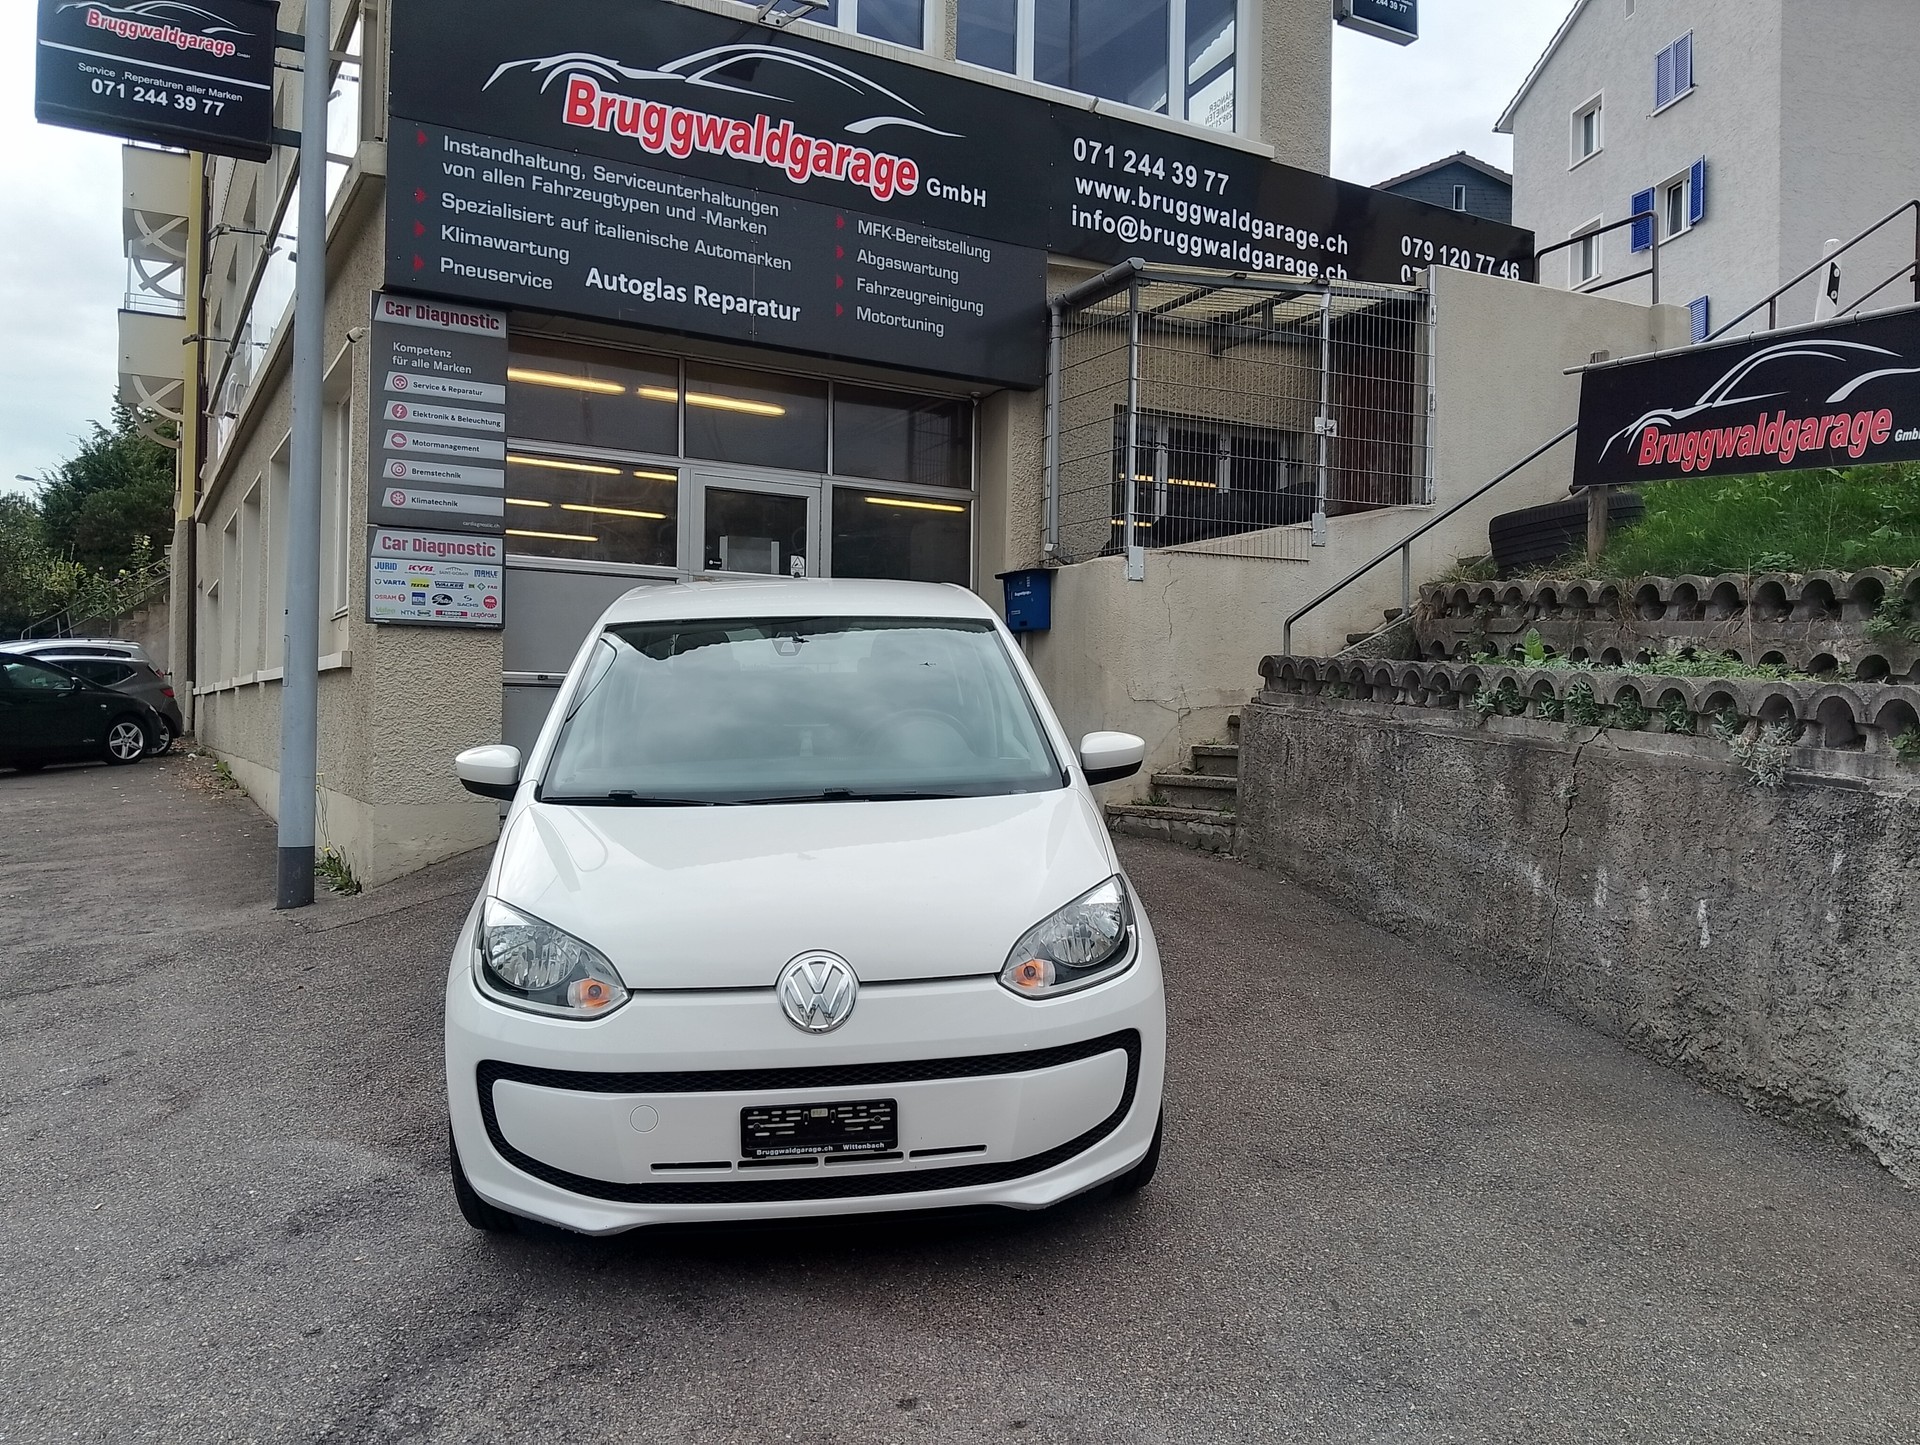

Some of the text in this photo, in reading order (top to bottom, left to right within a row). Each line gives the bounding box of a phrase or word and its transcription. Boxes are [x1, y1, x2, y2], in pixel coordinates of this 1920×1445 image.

[1400, 4, 1407, 13] 77
[86, 8, 235, 57] Bruggwaldgarage
[78, 62, 116, 78] Service
[186, 83, 206, 95] aller
[208, 87, 243, 102] Marken
[91, 78, 225, 116] 071 244 39 77
[562, 73, 987, 208] Bruggwaldgarage GmbH
[443, 134, 780, 218] Instandhaltung, Serviceunterhaltungen
[1073, 136, 1230, 196] 071 244 39 77
[442, 161, 768, 236] von allen Fahrzeugtypen und -Marken
[1074, 176, 1349, 256] www.bruggwaldgarage.ch
[441, 224, 570, 265] Klimawartung
[442, 192, 792, 272] Spezialisiert auf italienische Automarken
[857, 219, 991, 263] MFK-Bereitstellung
[1071, 205, 1348, 279] info@bruggwaldgarage.ch
[440, 256, 553, 291] Pneuservice
[857, 248, 960, 285] Abgaswartung
[1401, 235, 1520, 281] 079 120 77 46
[1401, 264, 1422, 283] 0
[585, 267, 801, 323] Autoglas Reparatur
[857, 277, 984, 316] Fahrzeugreinigung
[385, 301, 500, 330] Car Diagnostic
[857, 306, 944, 337] Motortuning
[392, 355, 472, 375] für alle Marken
[393, 341, 452, 359] Kompetenz
[413, 381, 440, 392] Service
[448, 386, 483, 396] Reparatur
[412, 410, 449, 421] Elektronik
[457, 415, 501, 427] Beleuchtung
[412, 439, 480, 452] Motormanagement
[1638, 408, 1920, 472] Bruggwaldgarage Gmb
[411, 468, 462, 479] Bremstechnik
[411, 497, 458, 507] Klimatechnik
[382, 536, 496, 557] Car Diagnostic
[374, 561, 398, 571] JURID
[383, 578, 406, 586] VARTA
[756, 1142, 884, 1156] Bruggwaldgarage.ch Wittenbach
